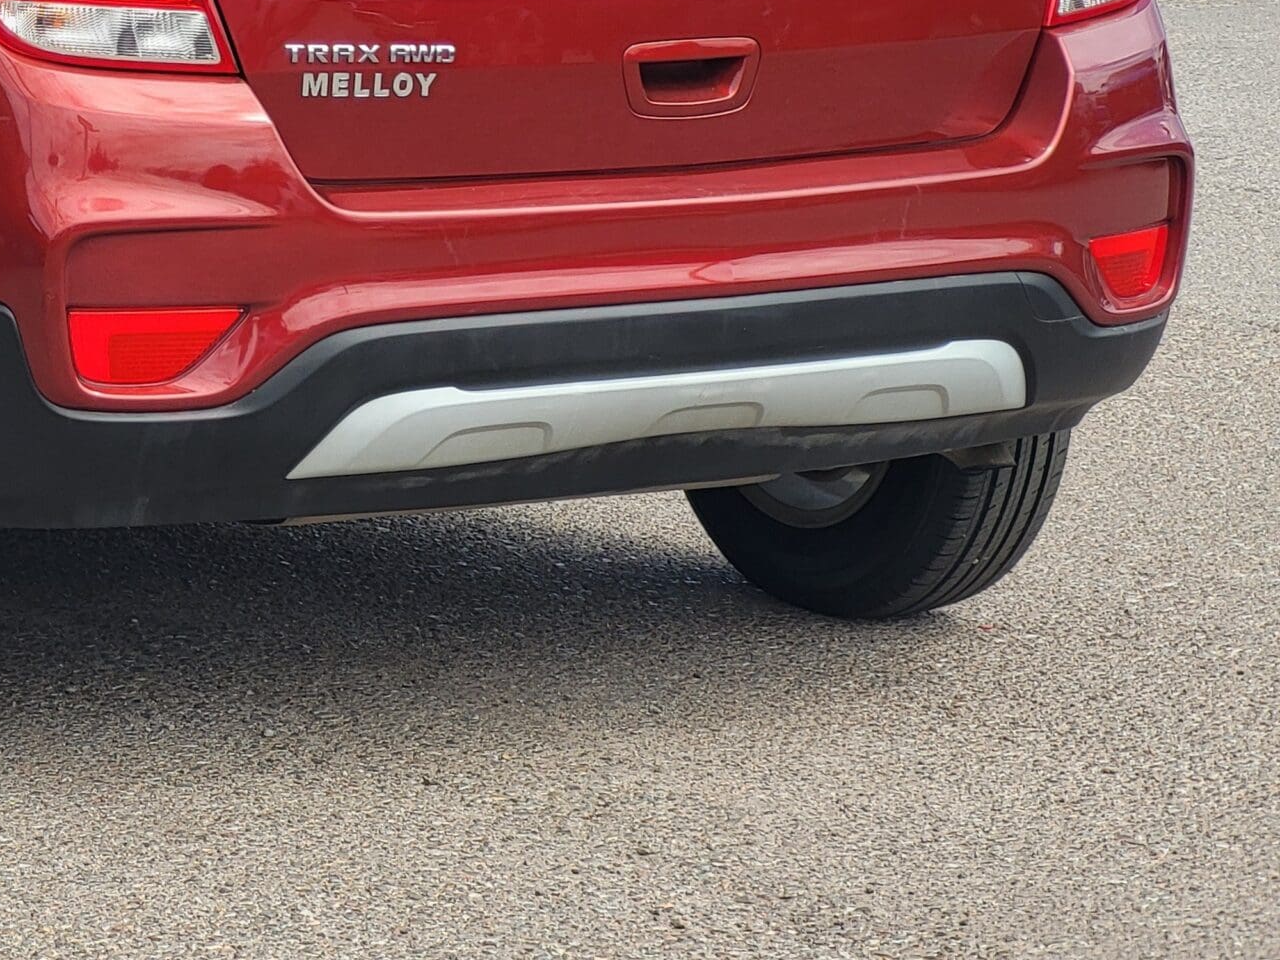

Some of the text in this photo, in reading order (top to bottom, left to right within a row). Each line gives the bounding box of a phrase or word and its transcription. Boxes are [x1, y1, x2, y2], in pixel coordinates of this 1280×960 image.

[284, 43, 457, 64] TRAX AWD
[301, 71, 438, 98] MELLOY
